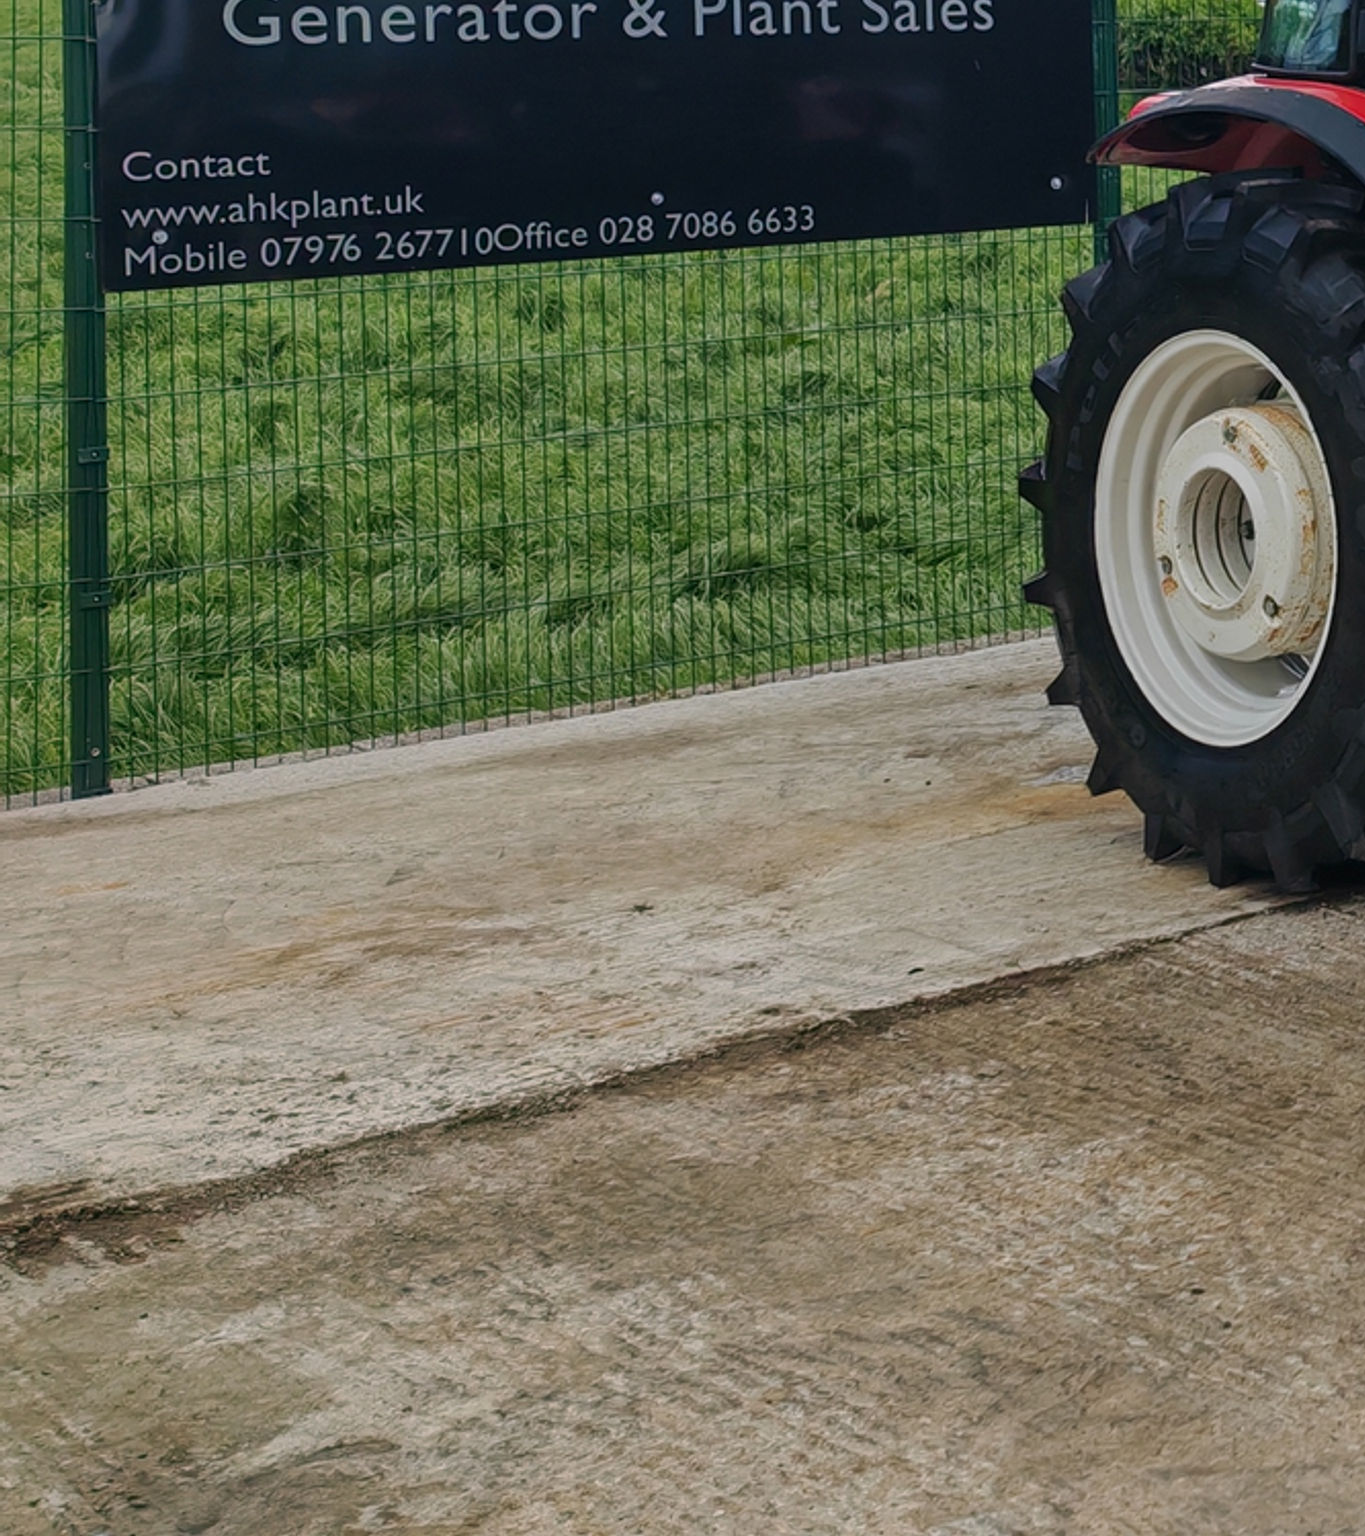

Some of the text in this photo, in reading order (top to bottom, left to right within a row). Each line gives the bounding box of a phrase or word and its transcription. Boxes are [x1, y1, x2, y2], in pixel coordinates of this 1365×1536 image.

[123, 152, 270, 180] Contact
[122, 185, 423, 228] www.ahkplant.uk
[125, 243, 246, 275] Mobile
[261, 234, 361, 266] 07976
[600, 216, 653, 243] 028
[666, 211, 735, 238] 7086
[749, 206, 813, 234] 6633
